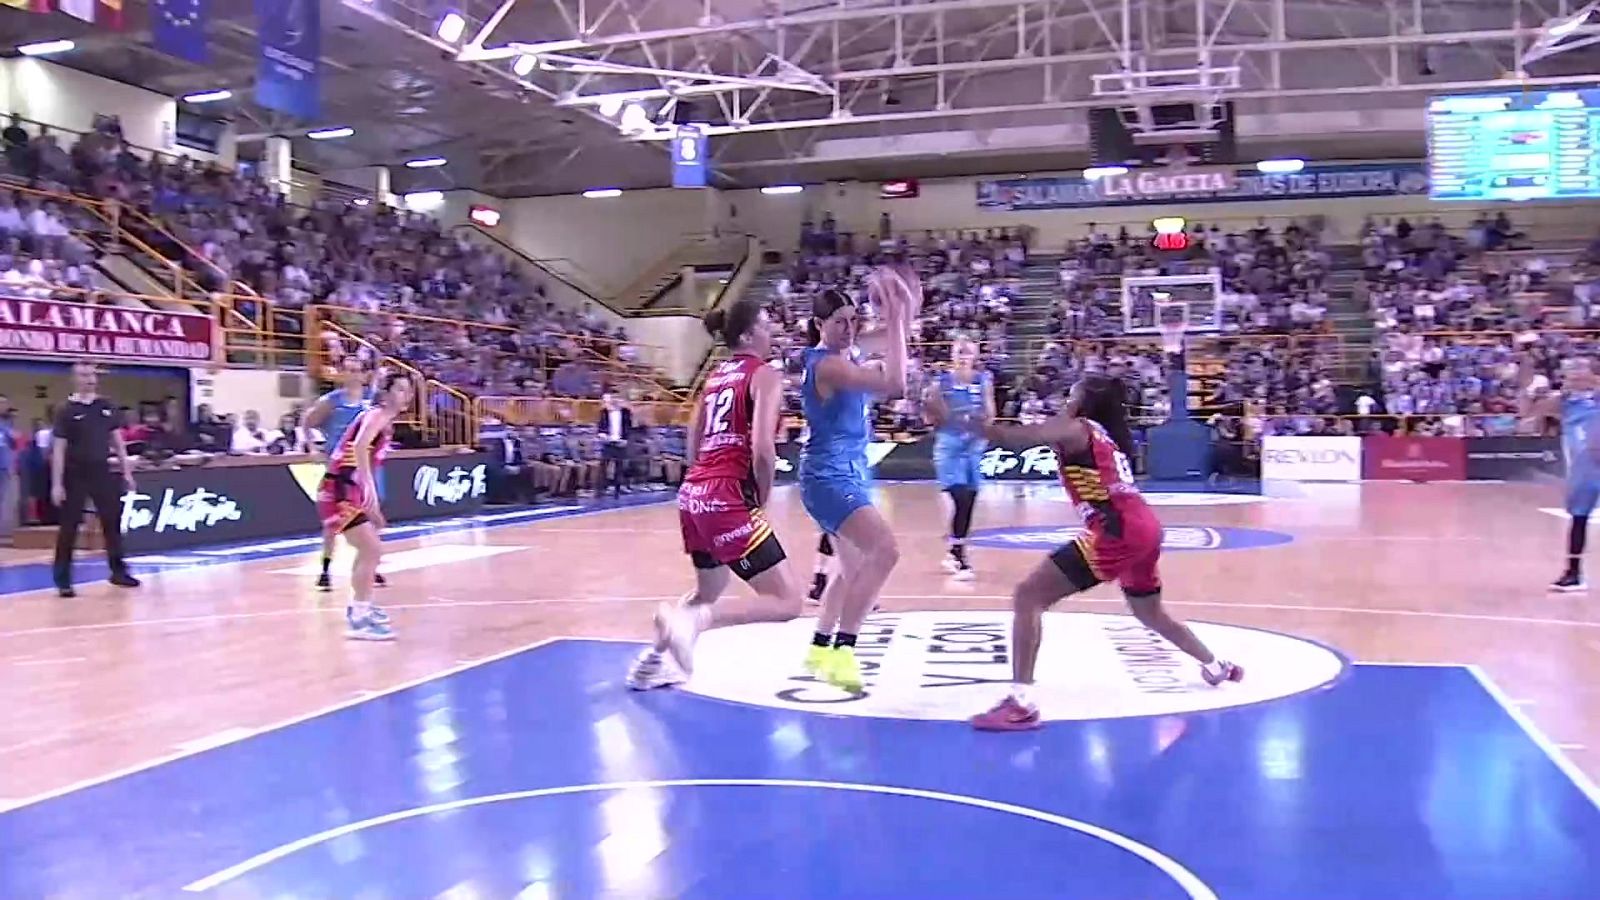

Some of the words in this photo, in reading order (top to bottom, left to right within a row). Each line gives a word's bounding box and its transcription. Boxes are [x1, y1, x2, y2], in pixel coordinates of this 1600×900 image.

[1104, 175, 1135, 196] LA
[1137, 172, 1226, 194] GACETA
[57, 332, 86, 352] DE
[87, 335, 112, 354] LA
[114, 337, 210, 359] HUMANIDAD
[704, 387, 735, 435] 12
[900, 621, 1010, 666] LEÓN
